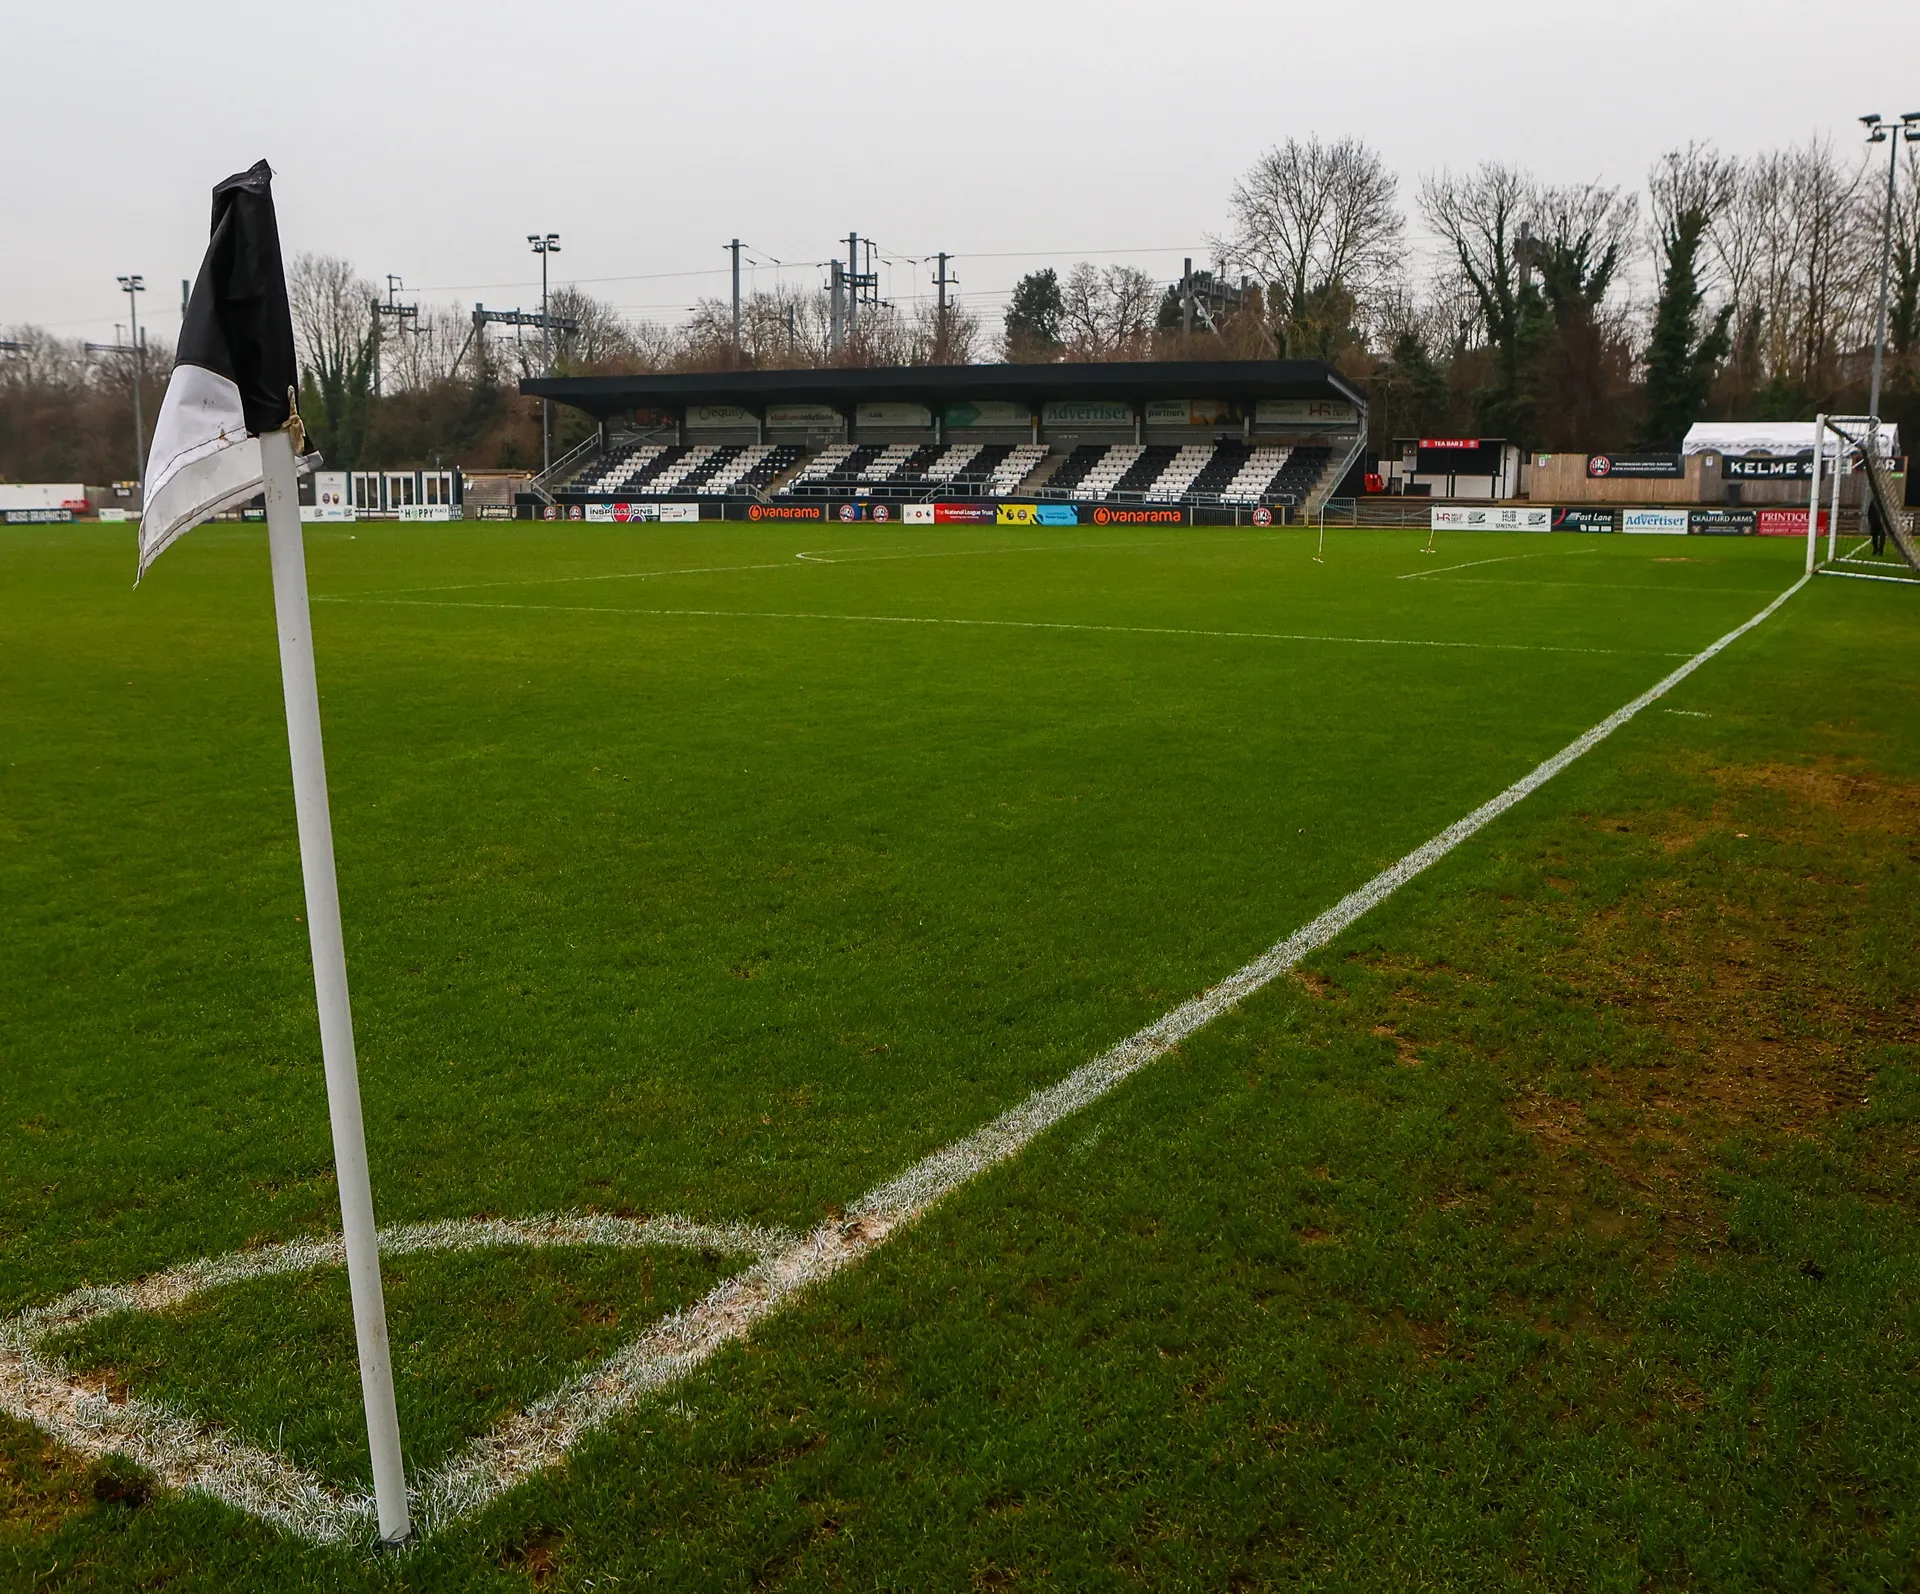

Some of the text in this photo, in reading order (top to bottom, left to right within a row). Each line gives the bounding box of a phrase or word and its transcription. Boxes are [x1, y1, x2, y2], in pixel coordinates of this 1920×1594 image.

[711, 407, 745, 419] equity
[1048, 405, 1127, 420] Advertiser
[1731, 461, 1798, 474] KELME
[762, 508, 820, 518] vanarama
[1112, 511, 1181, 522] vanarama
[1575, 512, 1612, 521] Fast Lane
[1626, 514, 1685, 525] Advertiser
